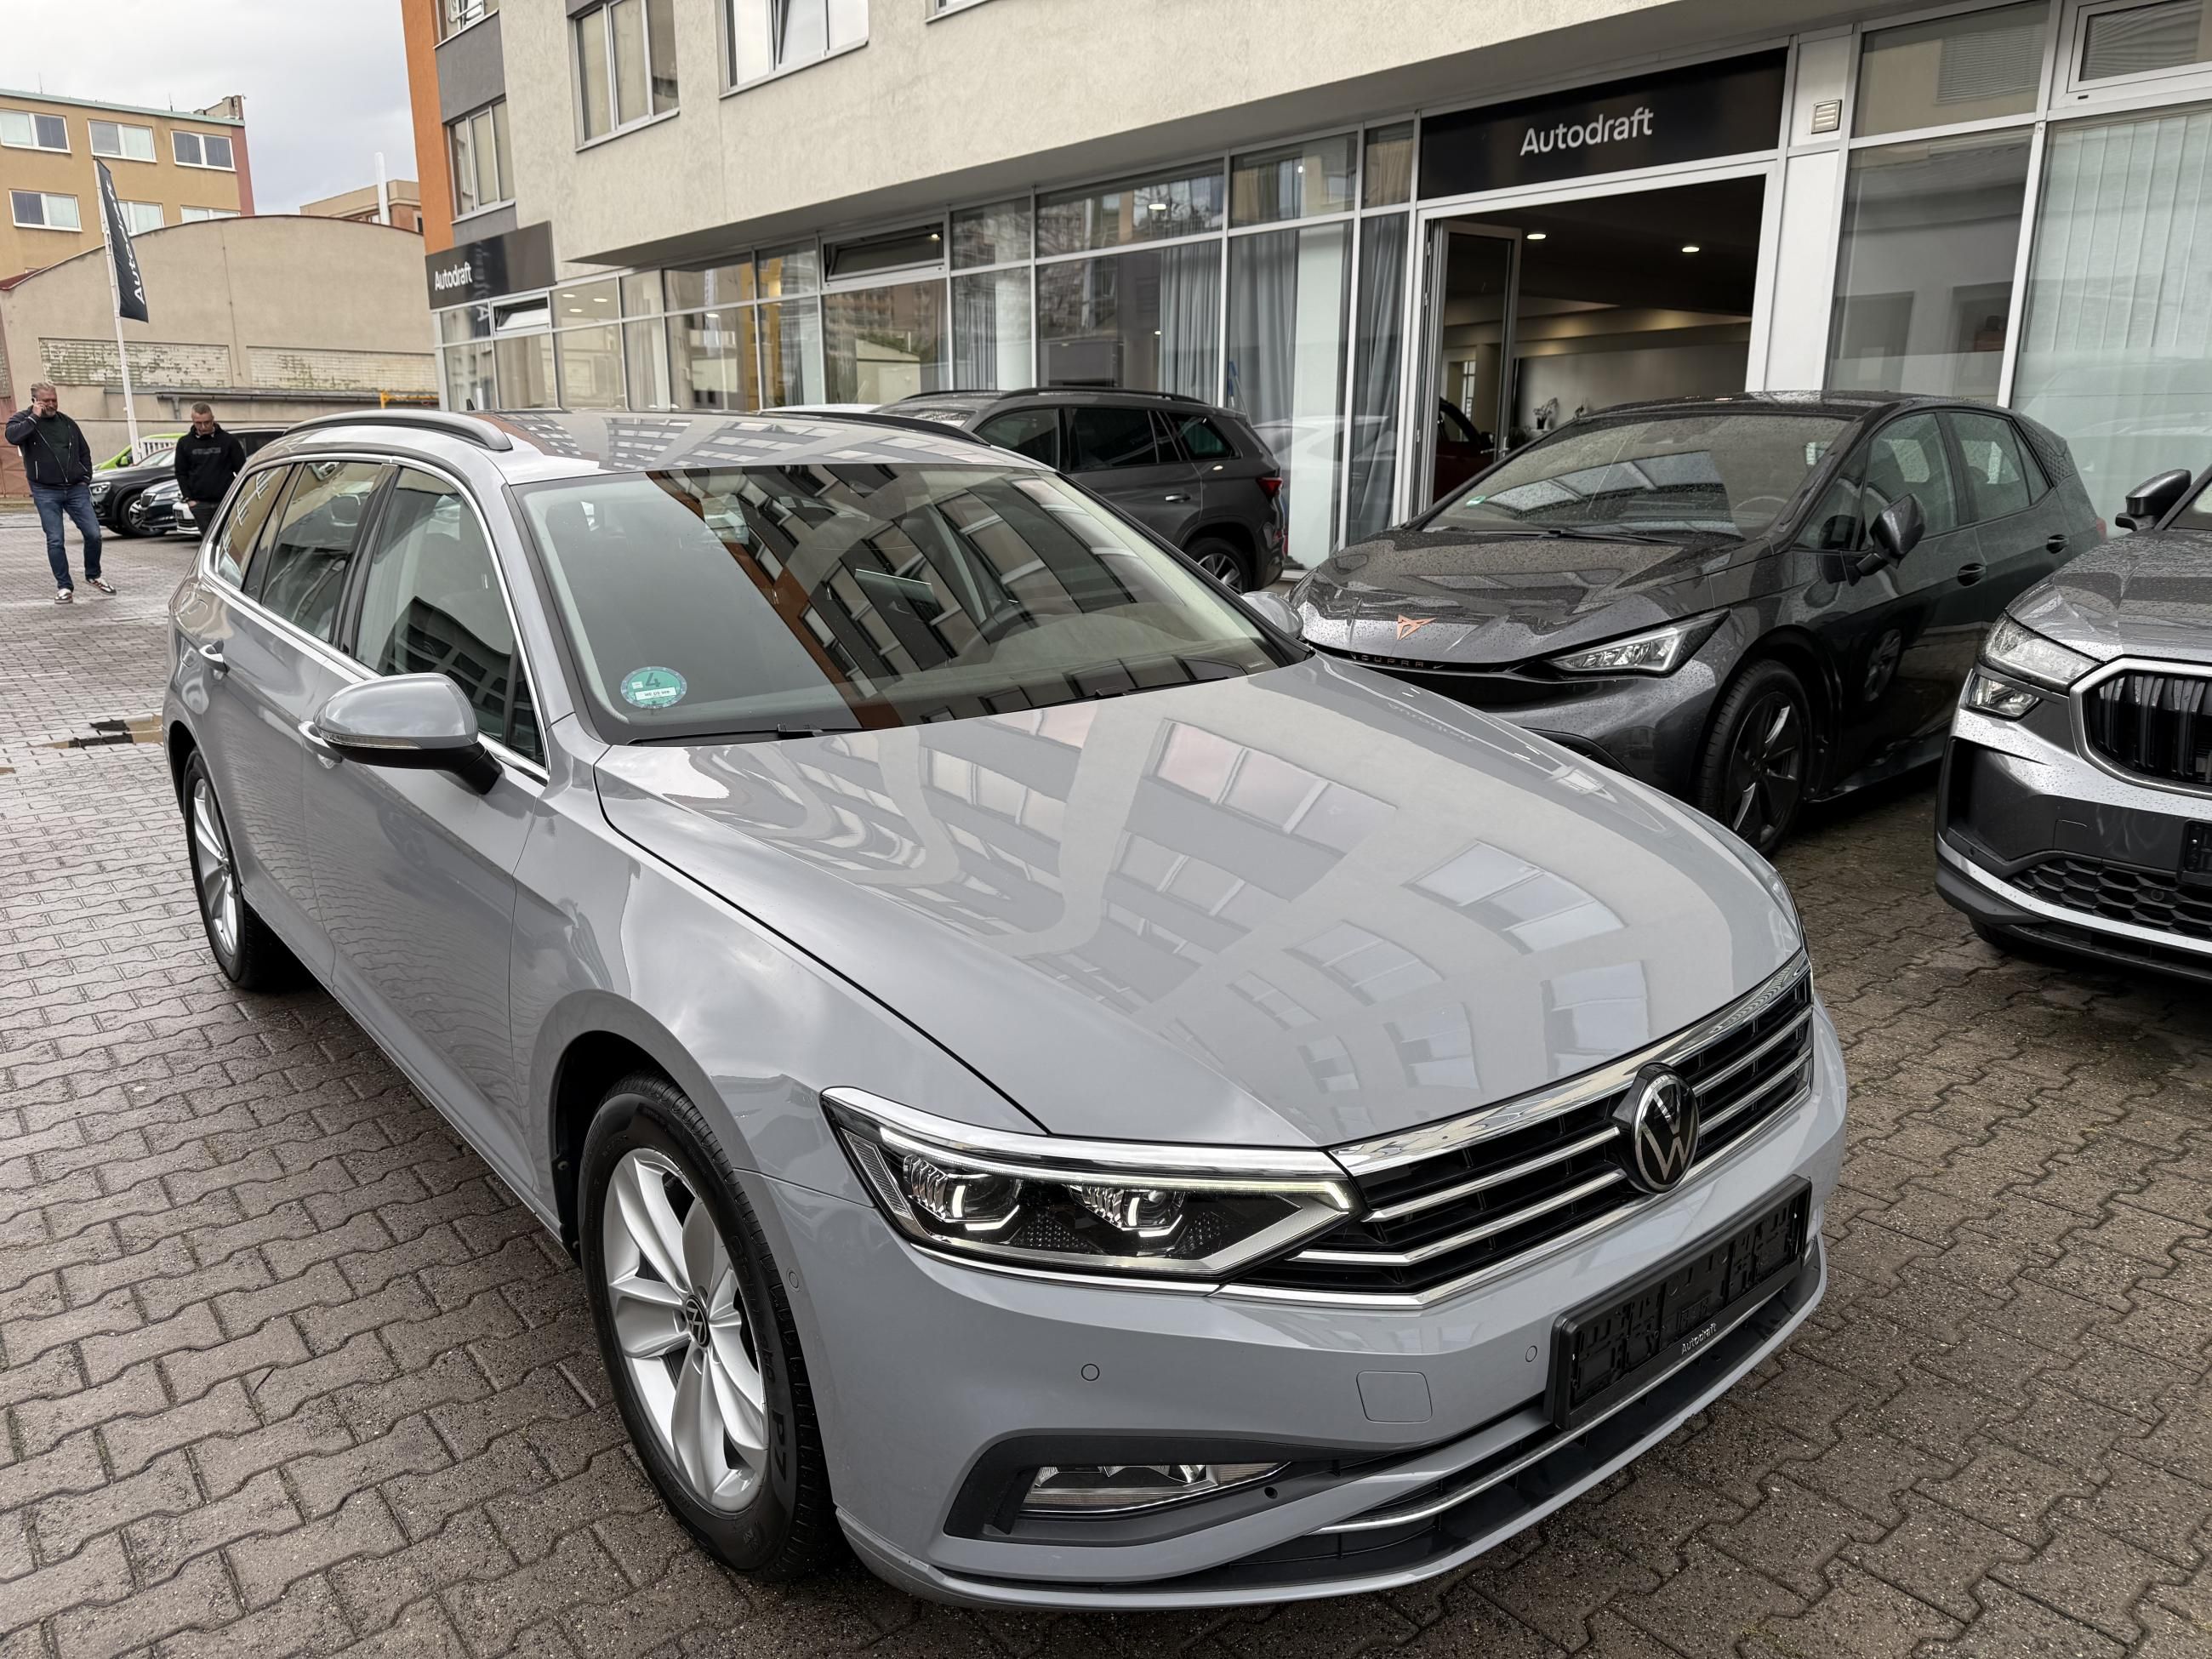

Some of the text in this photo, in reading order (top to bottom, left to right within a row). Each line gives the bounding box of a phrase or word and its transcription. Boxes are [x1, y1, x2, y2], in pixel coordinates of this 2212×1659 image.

[1519, 106, 1654, 157] Autodraft
[435, 261, 473, 291] Autodraft
[1361, 654, 1424, 668] CUPRA
[645, 672, 661, 687] 4
[1635, 1075, 1700, 1191] VW
[1681, 1322, 1717, 1355] Autodraft
